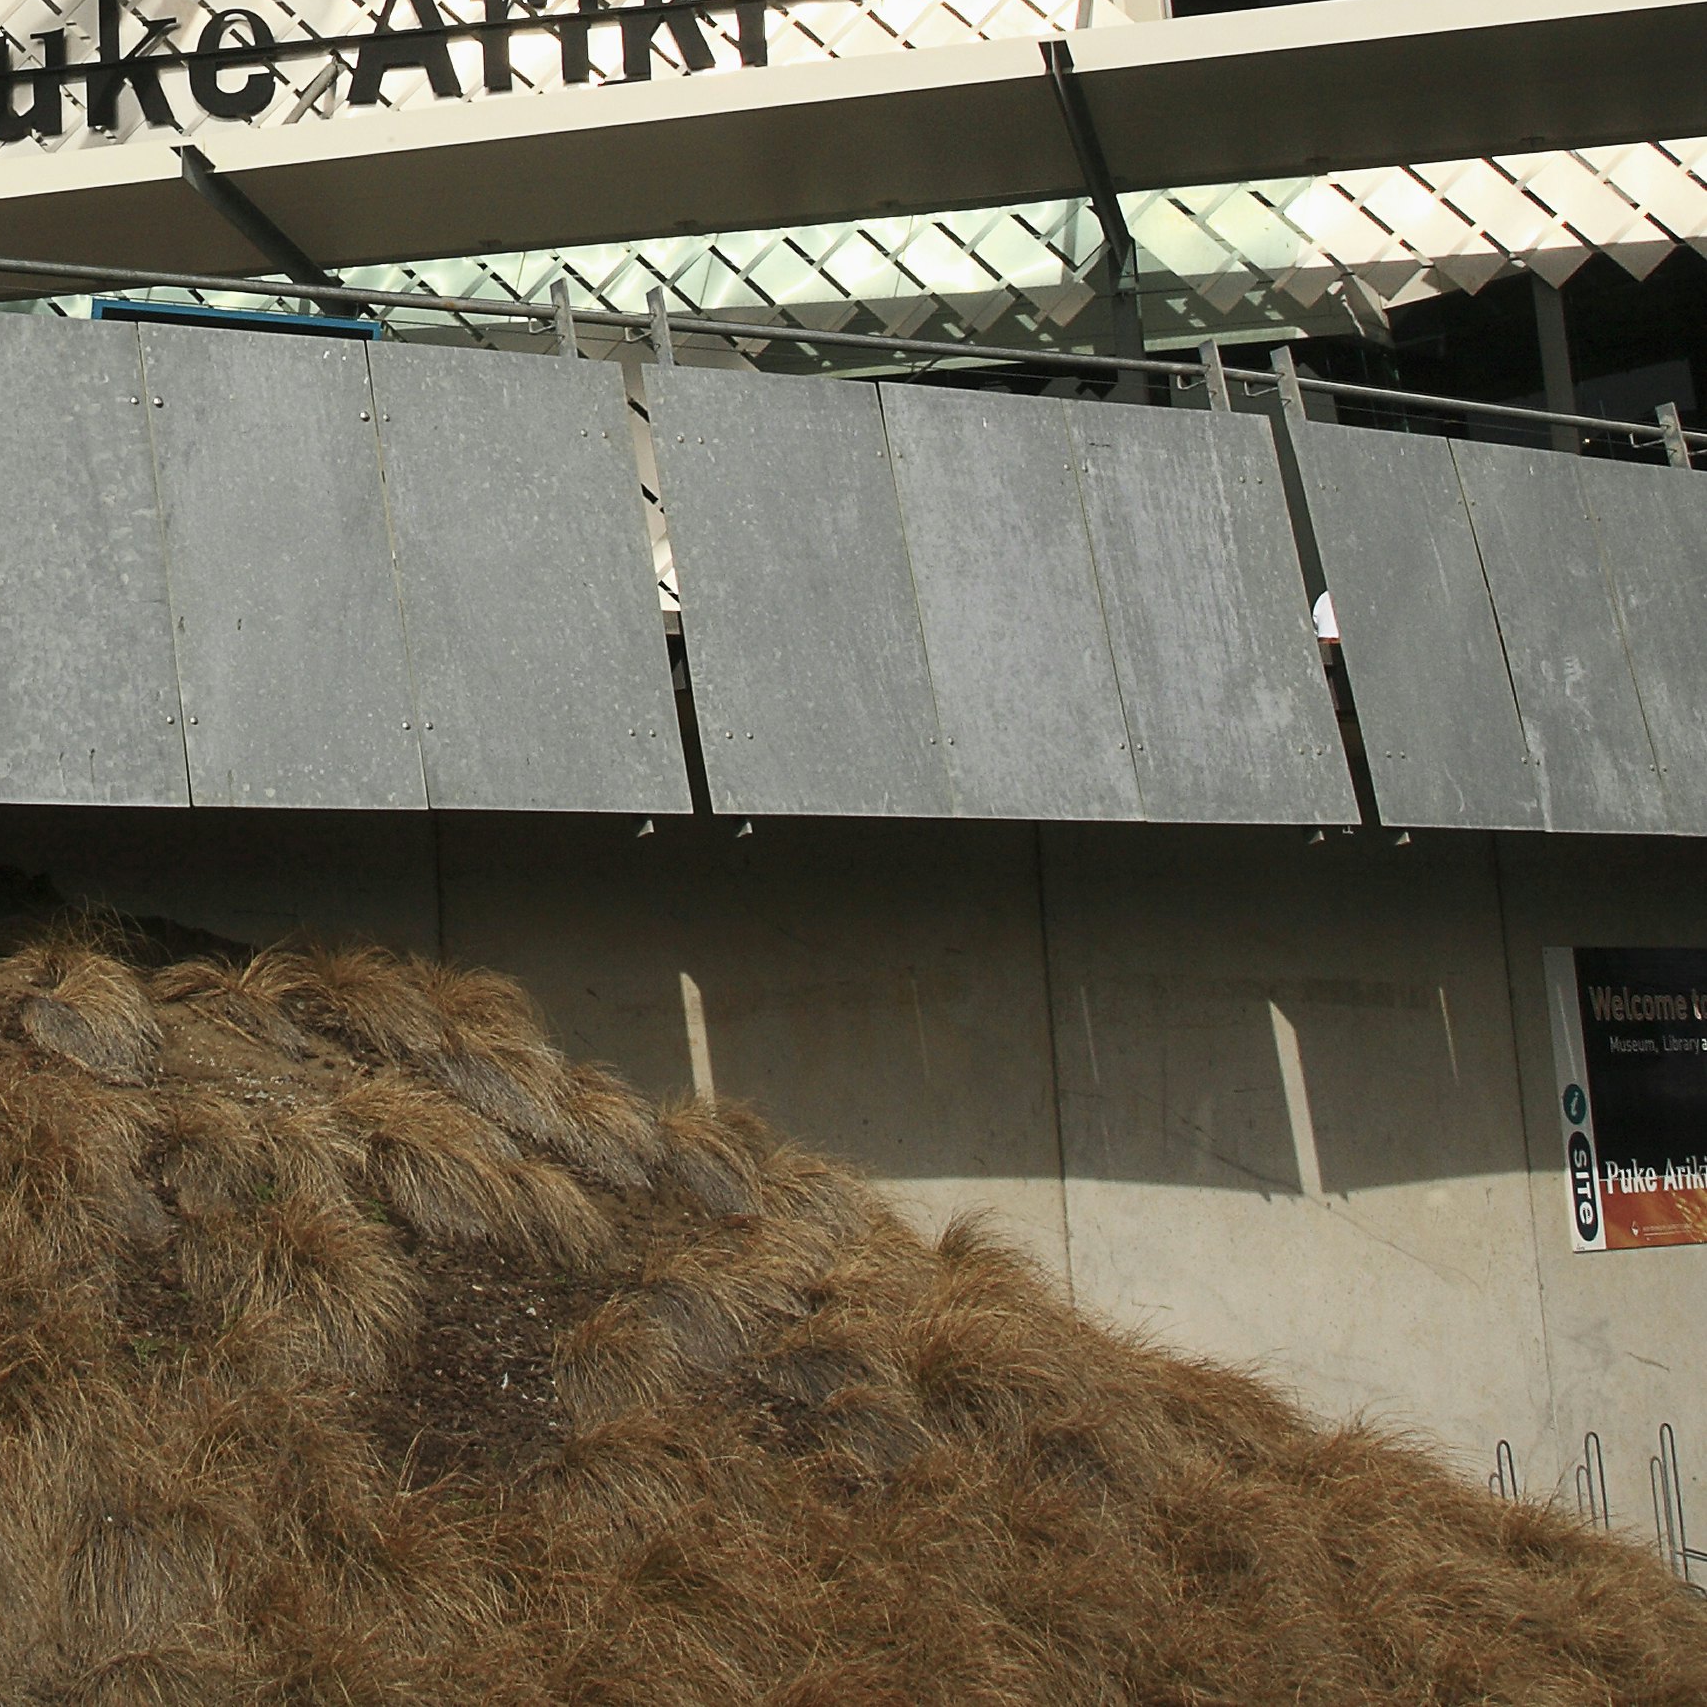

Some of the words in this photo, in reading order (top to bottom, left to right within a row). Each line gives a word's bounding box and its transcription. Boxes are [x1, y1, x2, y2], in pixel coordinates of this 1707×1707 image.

[1588, 985, 1688, 1021] Welcome
[1663, 1034, 1700, 1055] Library
[1605, 1157, 1658, 1195] Puke
